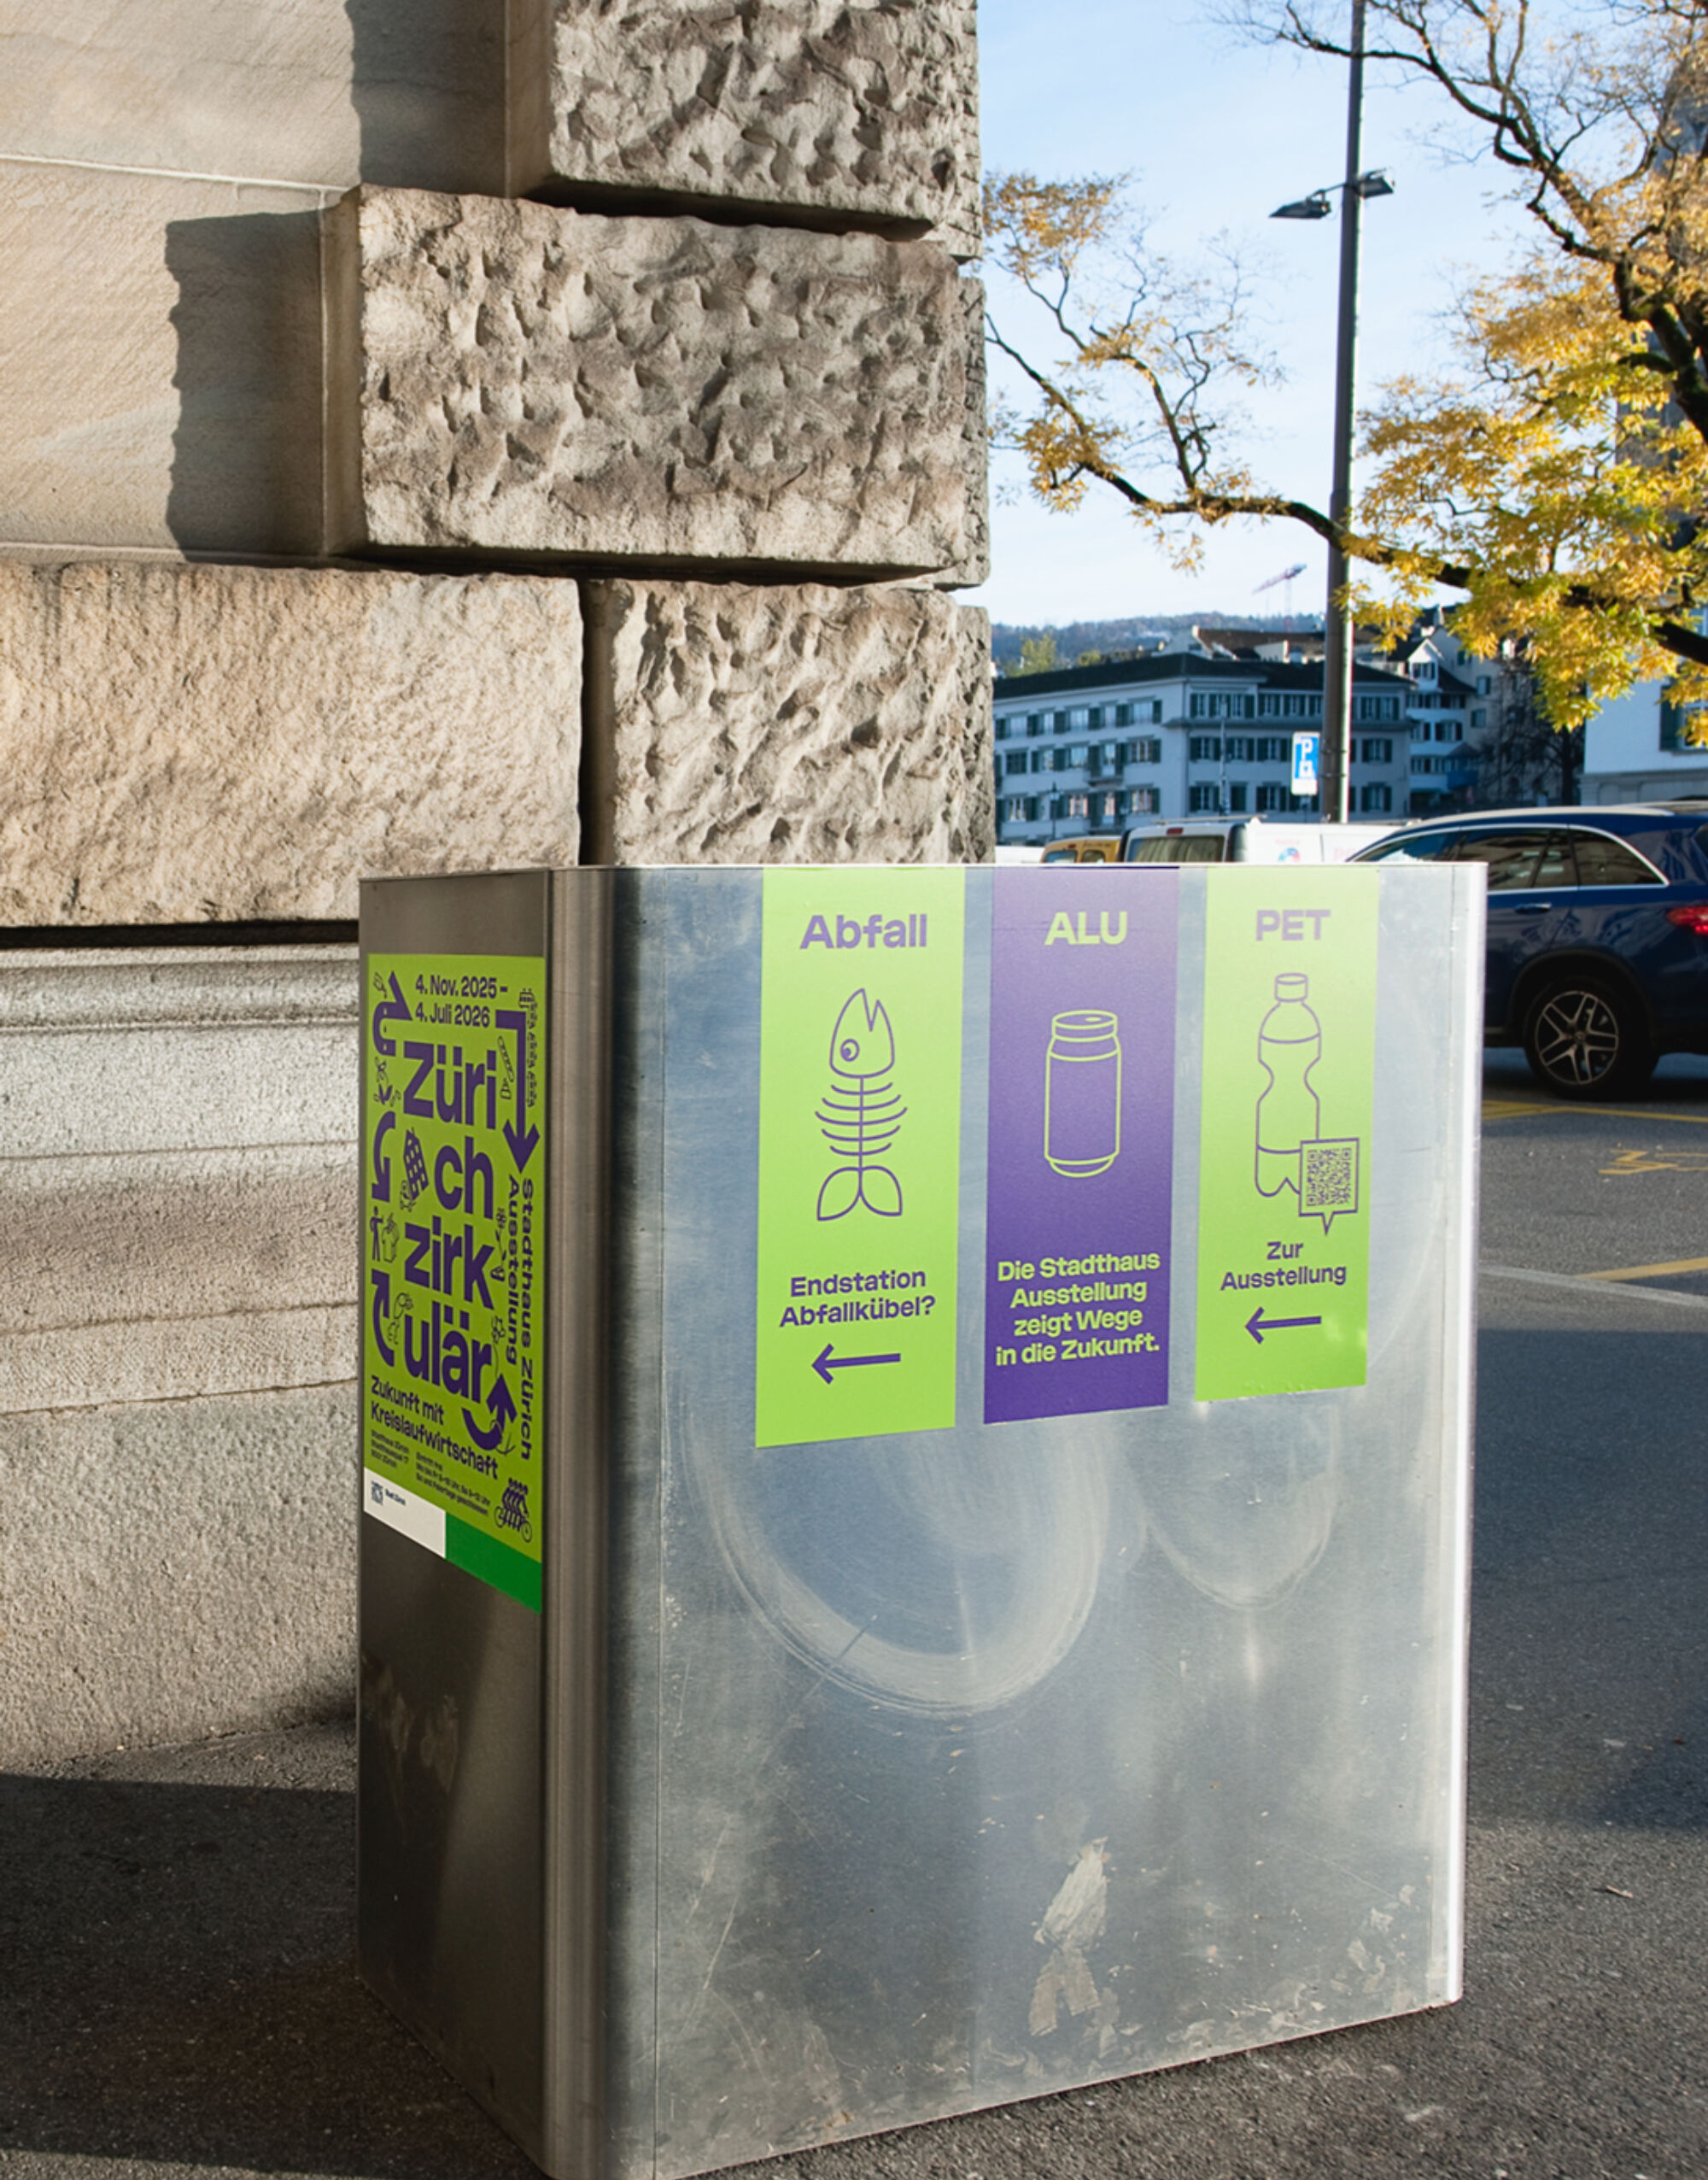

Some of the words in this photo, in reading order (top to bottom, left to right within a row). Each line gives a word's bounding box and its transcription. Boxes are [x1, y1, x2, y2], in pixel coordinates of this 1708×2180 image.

[799, 914, 927, 949] Abfall
[1044, 911, 1128, 946] ALU
[1255, 909, 1331, 941] PET
[415, 974, 428, 994] 4.
[430, 975, 459, 996] Nov.
[461, 976, 497, 999] 2025
[415, 1002, 428, 1023] 4.
[430, 1003, 452, 1023] Juli
[454, 1004, 490, 1028] 2026
[403, 1040, 496, 1130] Züri
[434, 1135, 494, 1220] ch
[404, 1215, 494, 1310] zirk
[521, 1178, 533, 1349] Stadthaus
[997, 1260, 1035, 1281] Die
[1039, 1252, 1161, 1278] Stadthaus
[1266, 1240, 1303, 1262] Zur
[506, 1175, 519, 1365] Ausstellung
[790, 1269, 926, 1298] Endstation
[1220, 1263, 1347, 1291] Ausstellung
[780, 1295, 936, 1327] Abfallkübel?
[1010, 1279, 1147, 1309] Ausstellung
[1014, 1312, 1072, 1339] zeigt
[1075, 1310, 1143, 1333] Wege
[404, 1300, 492, 1404] ulär
[996, 1346, 1016, 1366] in
[1021, 1341, 1056, 1363] die
[1061, 1333, 1160, 1360] Zukunft.
[371, 1374, 419, 1414] Zukunft
[422, 1401, 444, 1426] mit
[520, 1358, 533, 1460] Zürich
[371, 1400, 498, 1480] Kreislaufwirtschaft
